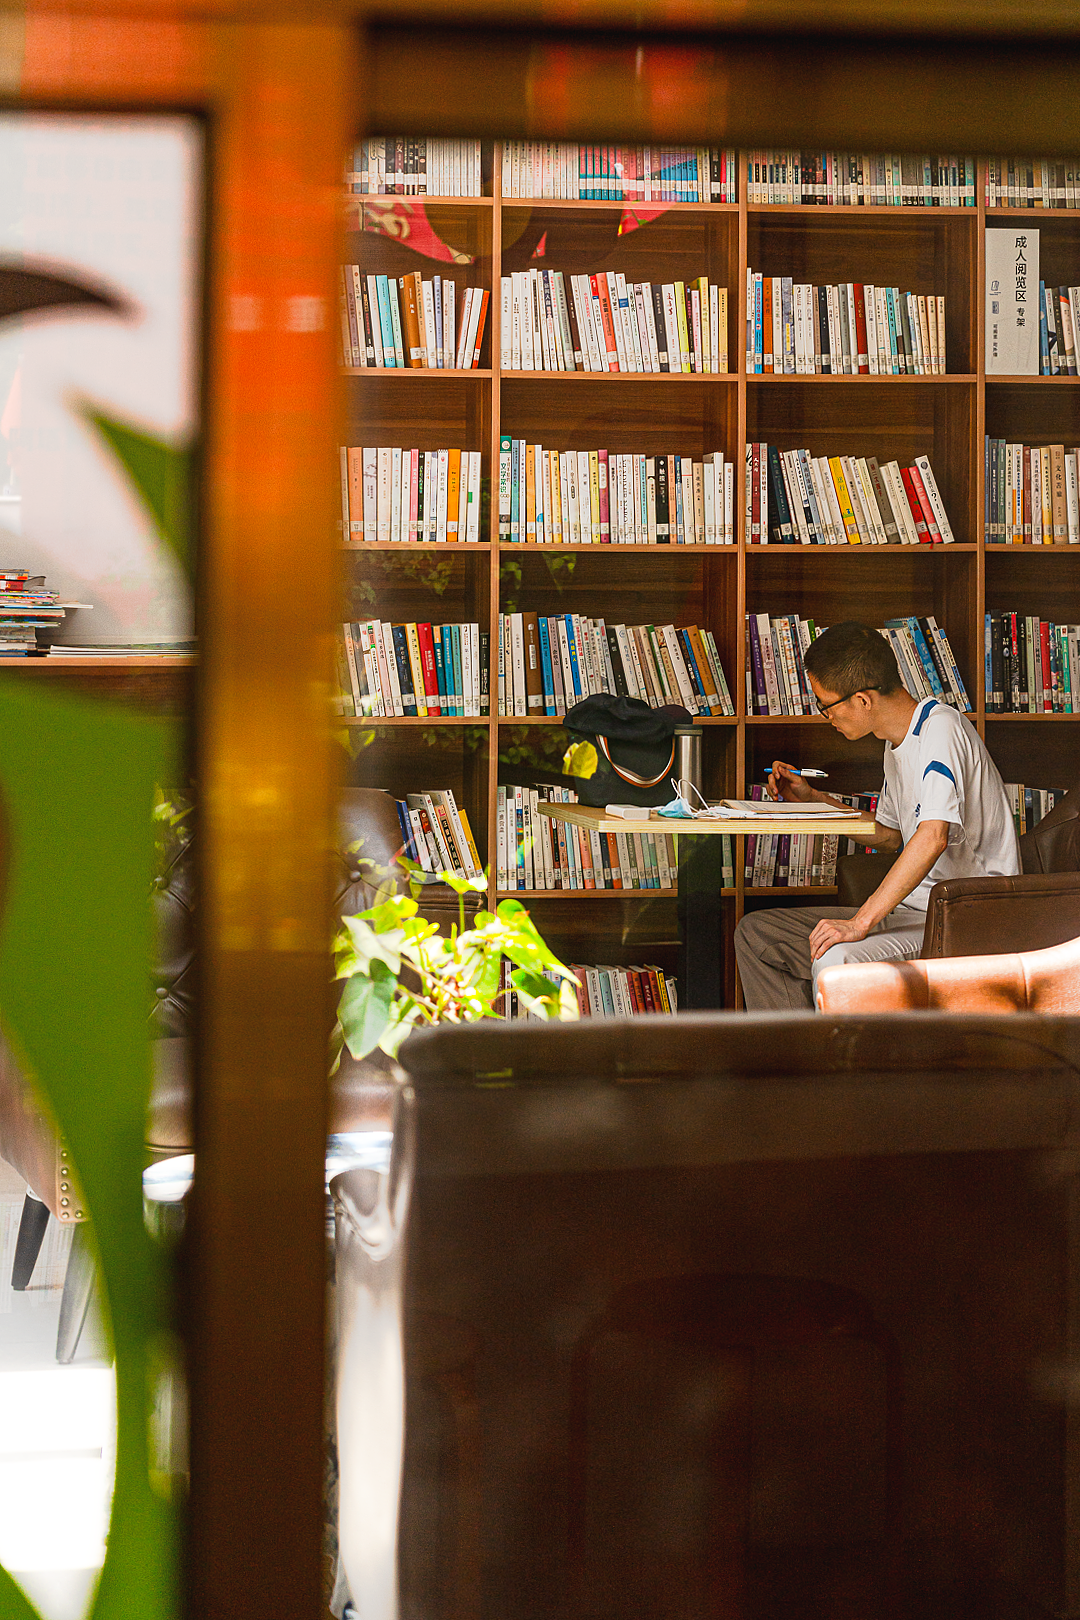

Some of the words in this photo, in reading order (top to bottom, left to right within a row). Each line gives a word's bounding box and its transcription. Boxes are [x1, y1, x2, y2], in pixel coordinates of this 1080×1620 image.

[1015, 236, 1027, 302] 成人阅览区
[1016, 307, 1025, 327] 专架
